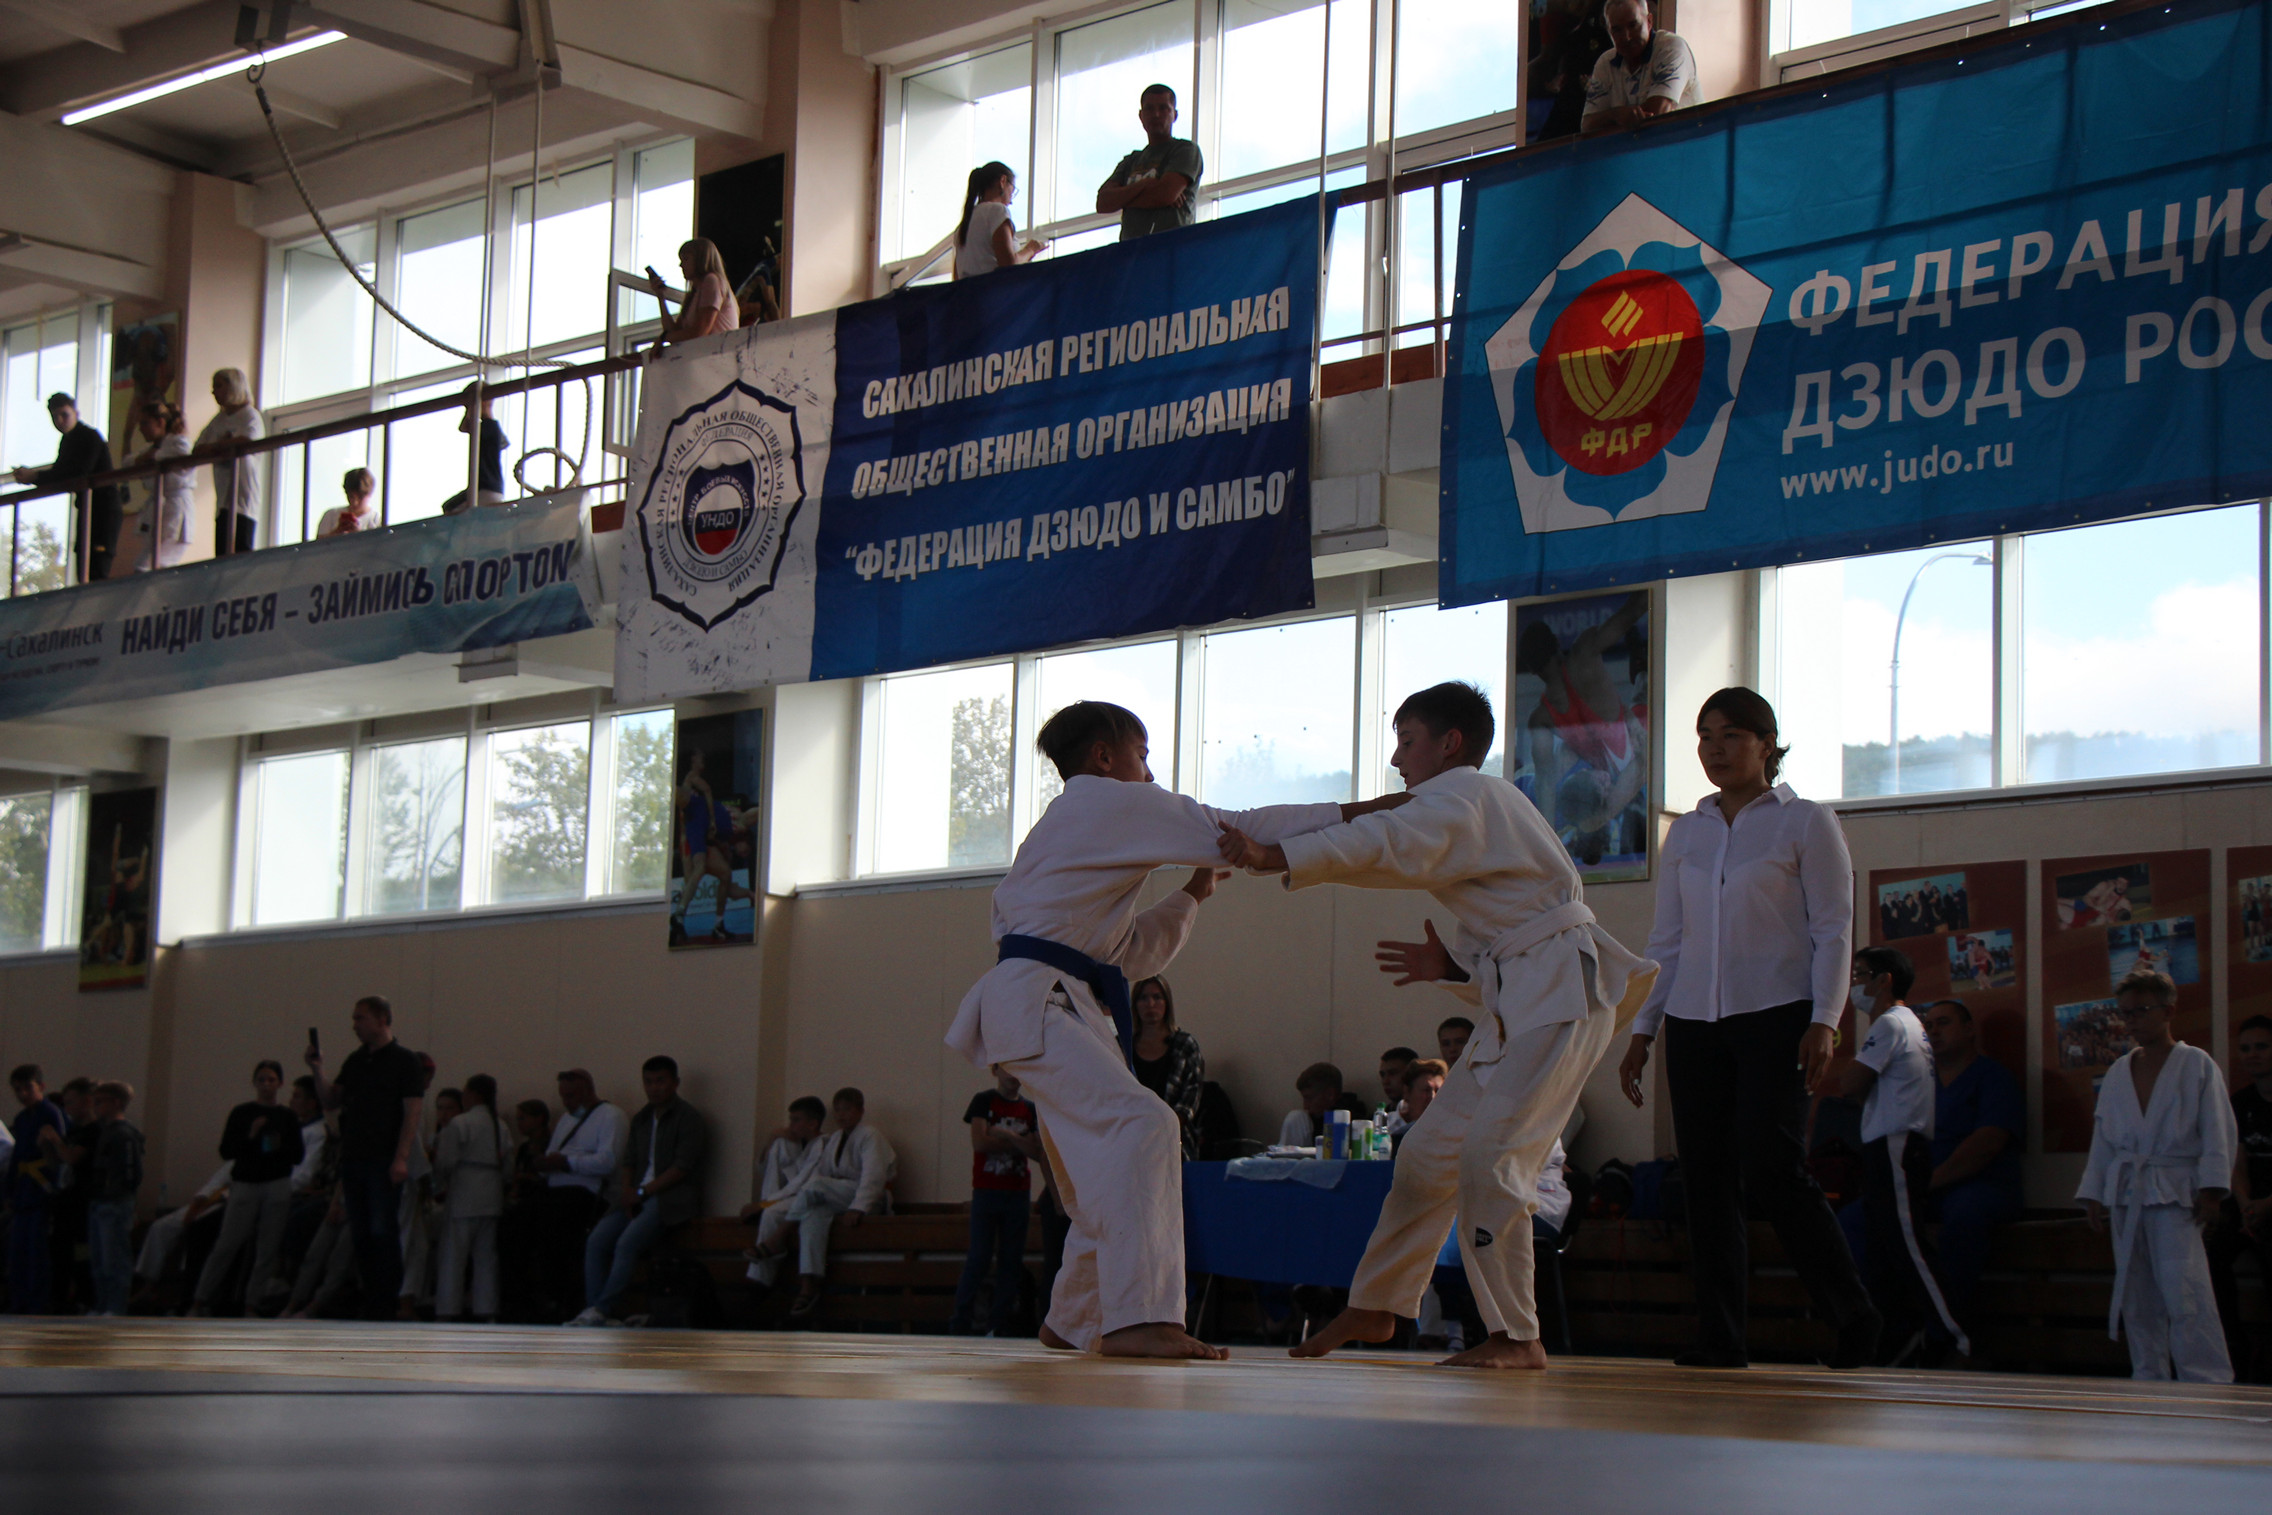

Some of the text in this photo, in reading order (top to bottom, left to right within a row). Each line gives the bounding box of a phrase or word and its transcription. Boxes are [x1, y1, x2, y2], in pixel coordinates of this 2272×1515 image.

[862, 286, 1290, 419] САХАЛИНСКАЯ РЕГИОНАЛЬНАЯ
[1781, 326, 2086, 455] ДЗЮДО
[850, 377, 1292, 500] ОБЩЕСТВЕННАЯ ОРГАНИЗАЦИЯ
[1581, 422, 1652, 458] ФДР
[1780, 442, 2013, 499] www.judo.ru
[701, 511, 735, 528] УНДО
[1026, 497, 1140, 562] ДЗЮДО
[1149, 491, 1169, 535] И
[120, 607, 203, 655] НАЙДИ
[211, 592, 277, 640] СЕБЯ
[308, 565, 434, 623] ЗАЙМИСЬ
